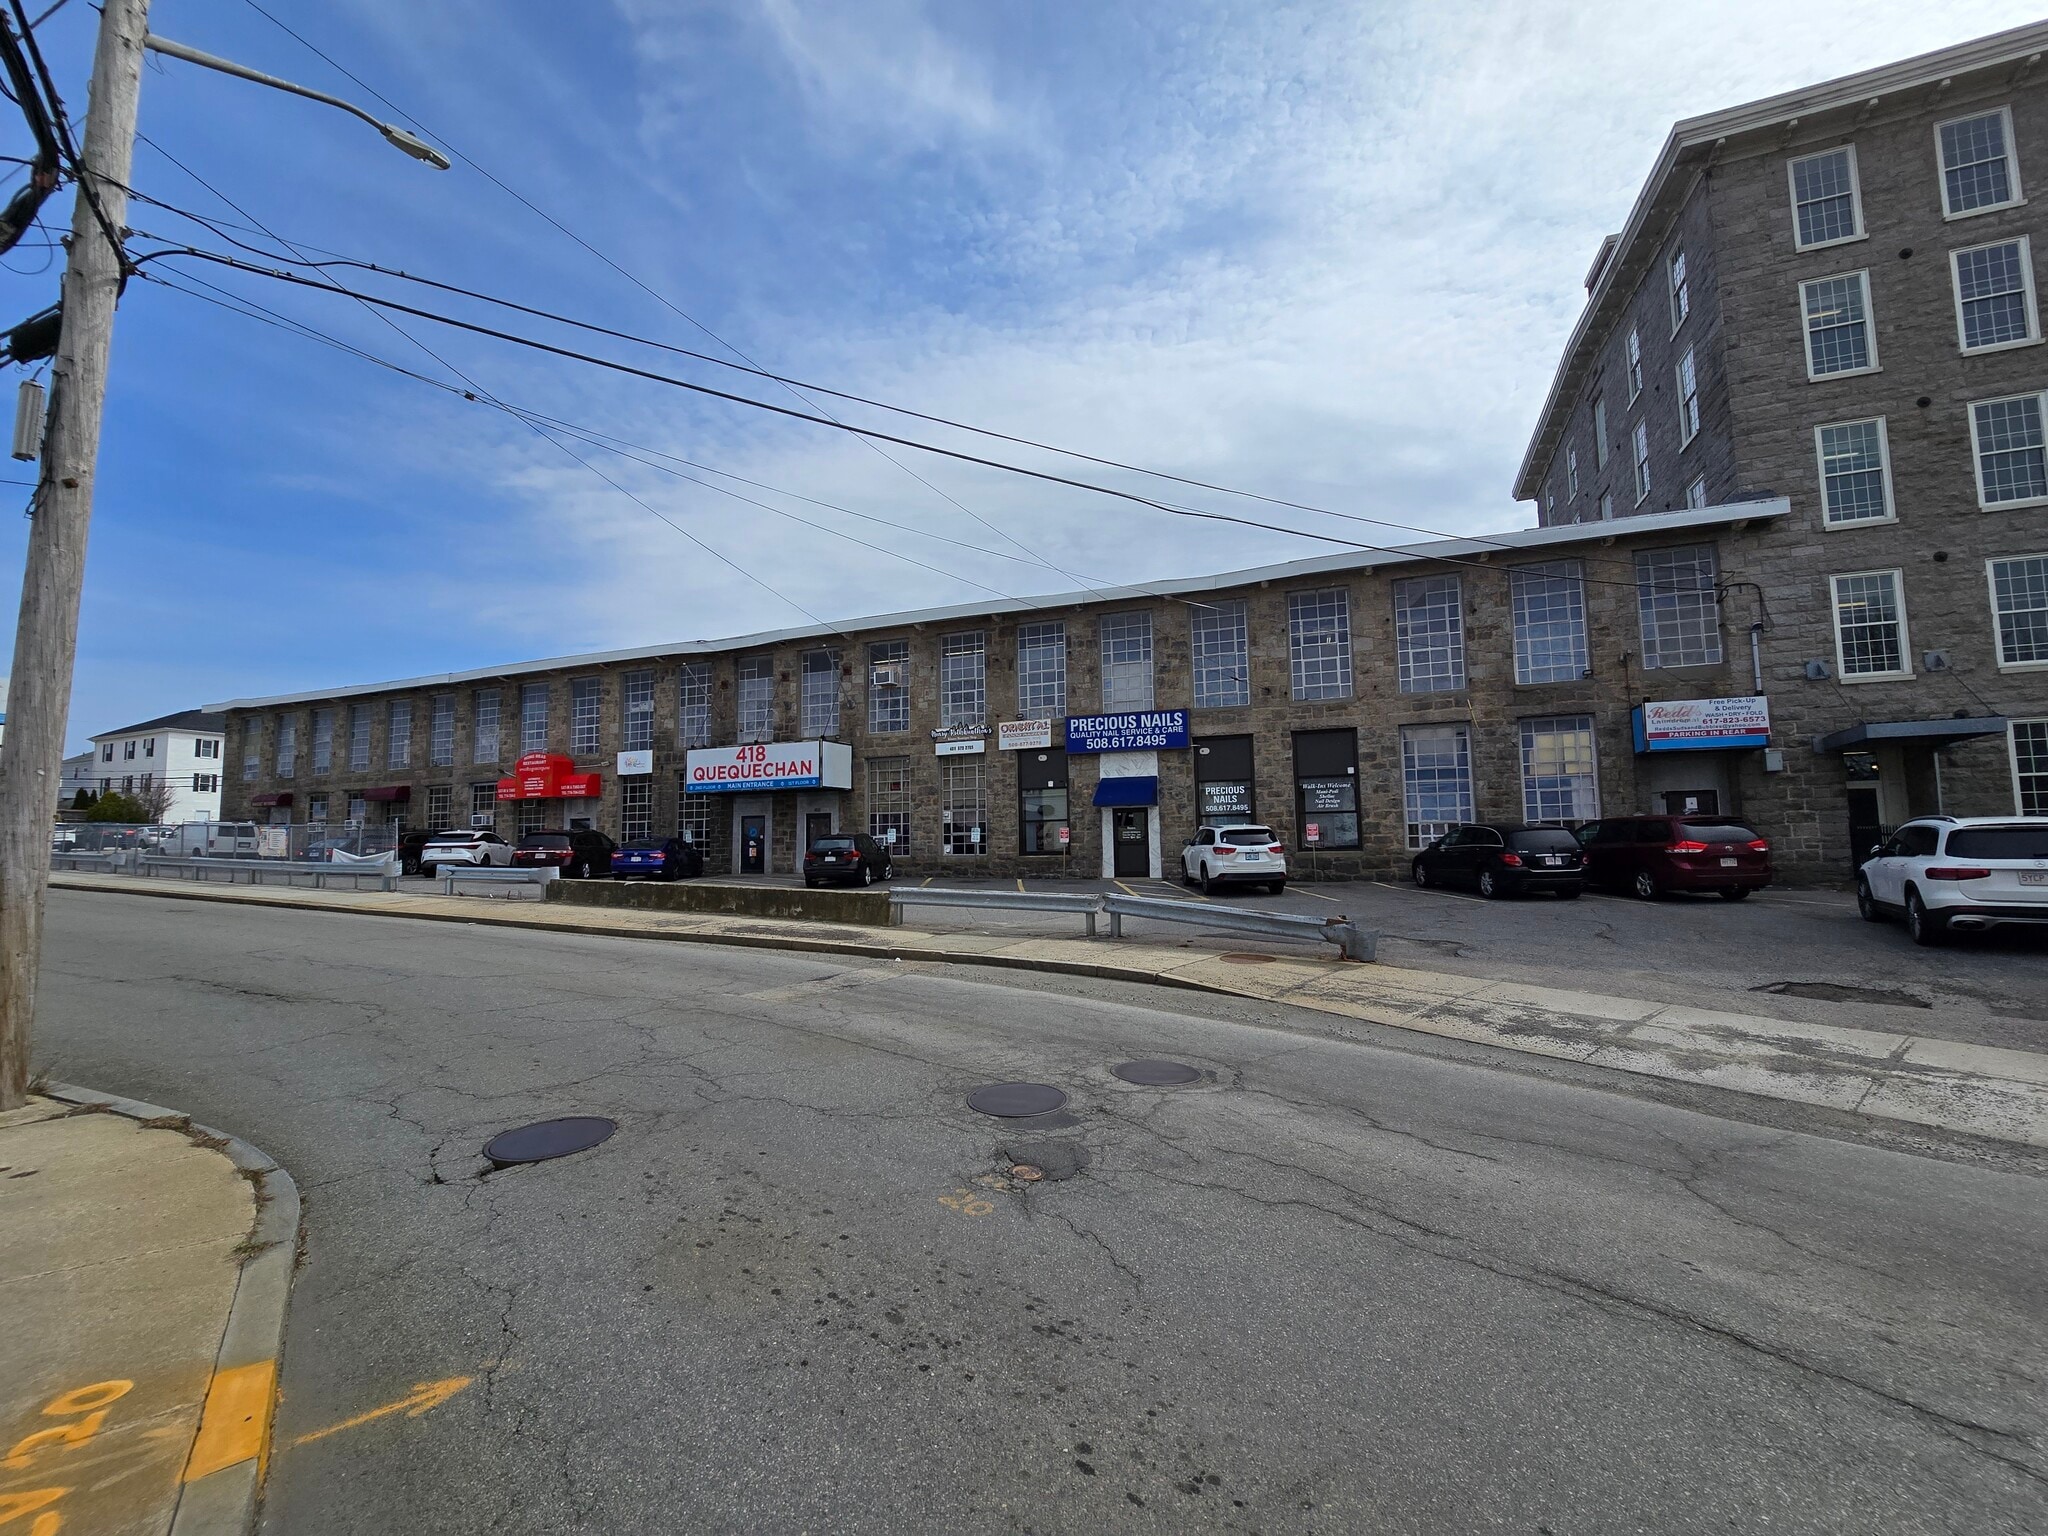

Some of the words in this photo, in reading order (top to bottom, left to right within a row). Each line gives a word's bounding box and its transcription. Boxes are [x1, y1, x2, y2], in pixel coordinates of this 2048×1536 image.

[1070, 715, 1137, 732] PRECIOUS
[1141, 712, 1183, 728] NAILS
[1702, 716, 1766, 725] 617-823-6573
[1070, 730, 1101, 739] QUALITY
[1102, 729, 1120, 737] NAIL
[1121, 727, 1153, 736] SERVICE
[1162, 725, 1184, 733] CARE
[1668, 730, 1707, 738] PARKING
[1086, 734, 1167, 750] 508.617.8495
[735, 745, 766, 763] 418
[693, 760, 812, 782] QUEQUECHAN
[1205, 785, 1245, 795] PRECIOUS
[1213, 795, 1237, 804] NAILS
[1205, 804, 1249, 812] 508.617.8495
